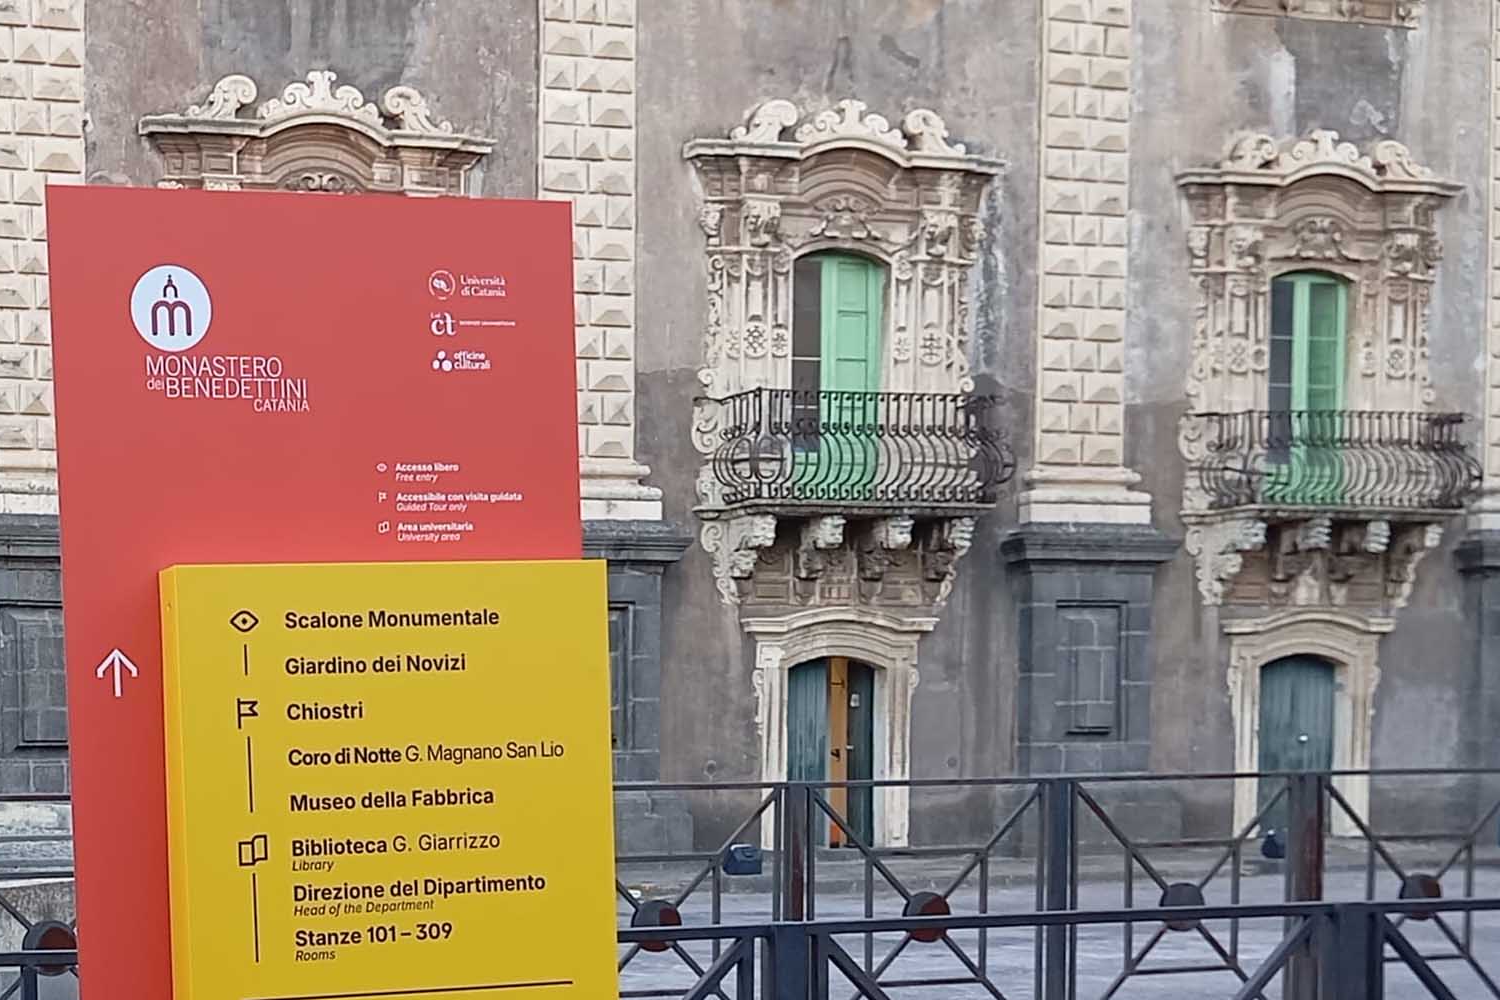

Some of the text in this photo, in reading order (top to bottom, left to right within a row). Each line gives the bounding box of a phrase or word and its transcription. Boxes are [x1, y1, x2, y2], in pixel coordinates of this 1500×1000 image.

[460, 275, 505, 285] Università
[461, 287, 505, 296] di Catania
[454, 351, 485, 360] officine
[146, 356, 282, 377] MONASTERO
[454, 356, 490, 369] culturali
[147, 378, 307, 399] dei BENEDETTINI
[254, 399, 309, 412] CATANIA
[395, 463, 459, 472] Accesso libero
[395, 473, 438, 483] Free entry
[396, 493, 445, 501] Accessibile
[490, 492, 522, 502] guidata
[397, 503, 467, 513] Guided Tour only
[397, 523, 473, 531] Area universitaria
[397, 533, 439, 542] University
[285, 609, 499, 628] Scalone Monumentale
[285, 654, 466, 675] Giardino dei Novizi
[287, 702, 363, 720] Chiostri
[288, 741, 564, 766] Coro di Notte G. Magnano San Lio
[291, 788, 494, 812] Museo della Fabbrica
[292, 832, 500, 856] Biblioteca G. Giarrizzo
[292, 860, 334, 872] Library
[294, 875, 546, 901] Direzione del Dipartimento
[294, 899, 434, 917] Head of the Department
[295, 928, 362, 947] Stanze
[367, 926, 396, 942] 101
[416, 923, 452, 940] 309
[295, 950, 335, 962] Rooms
